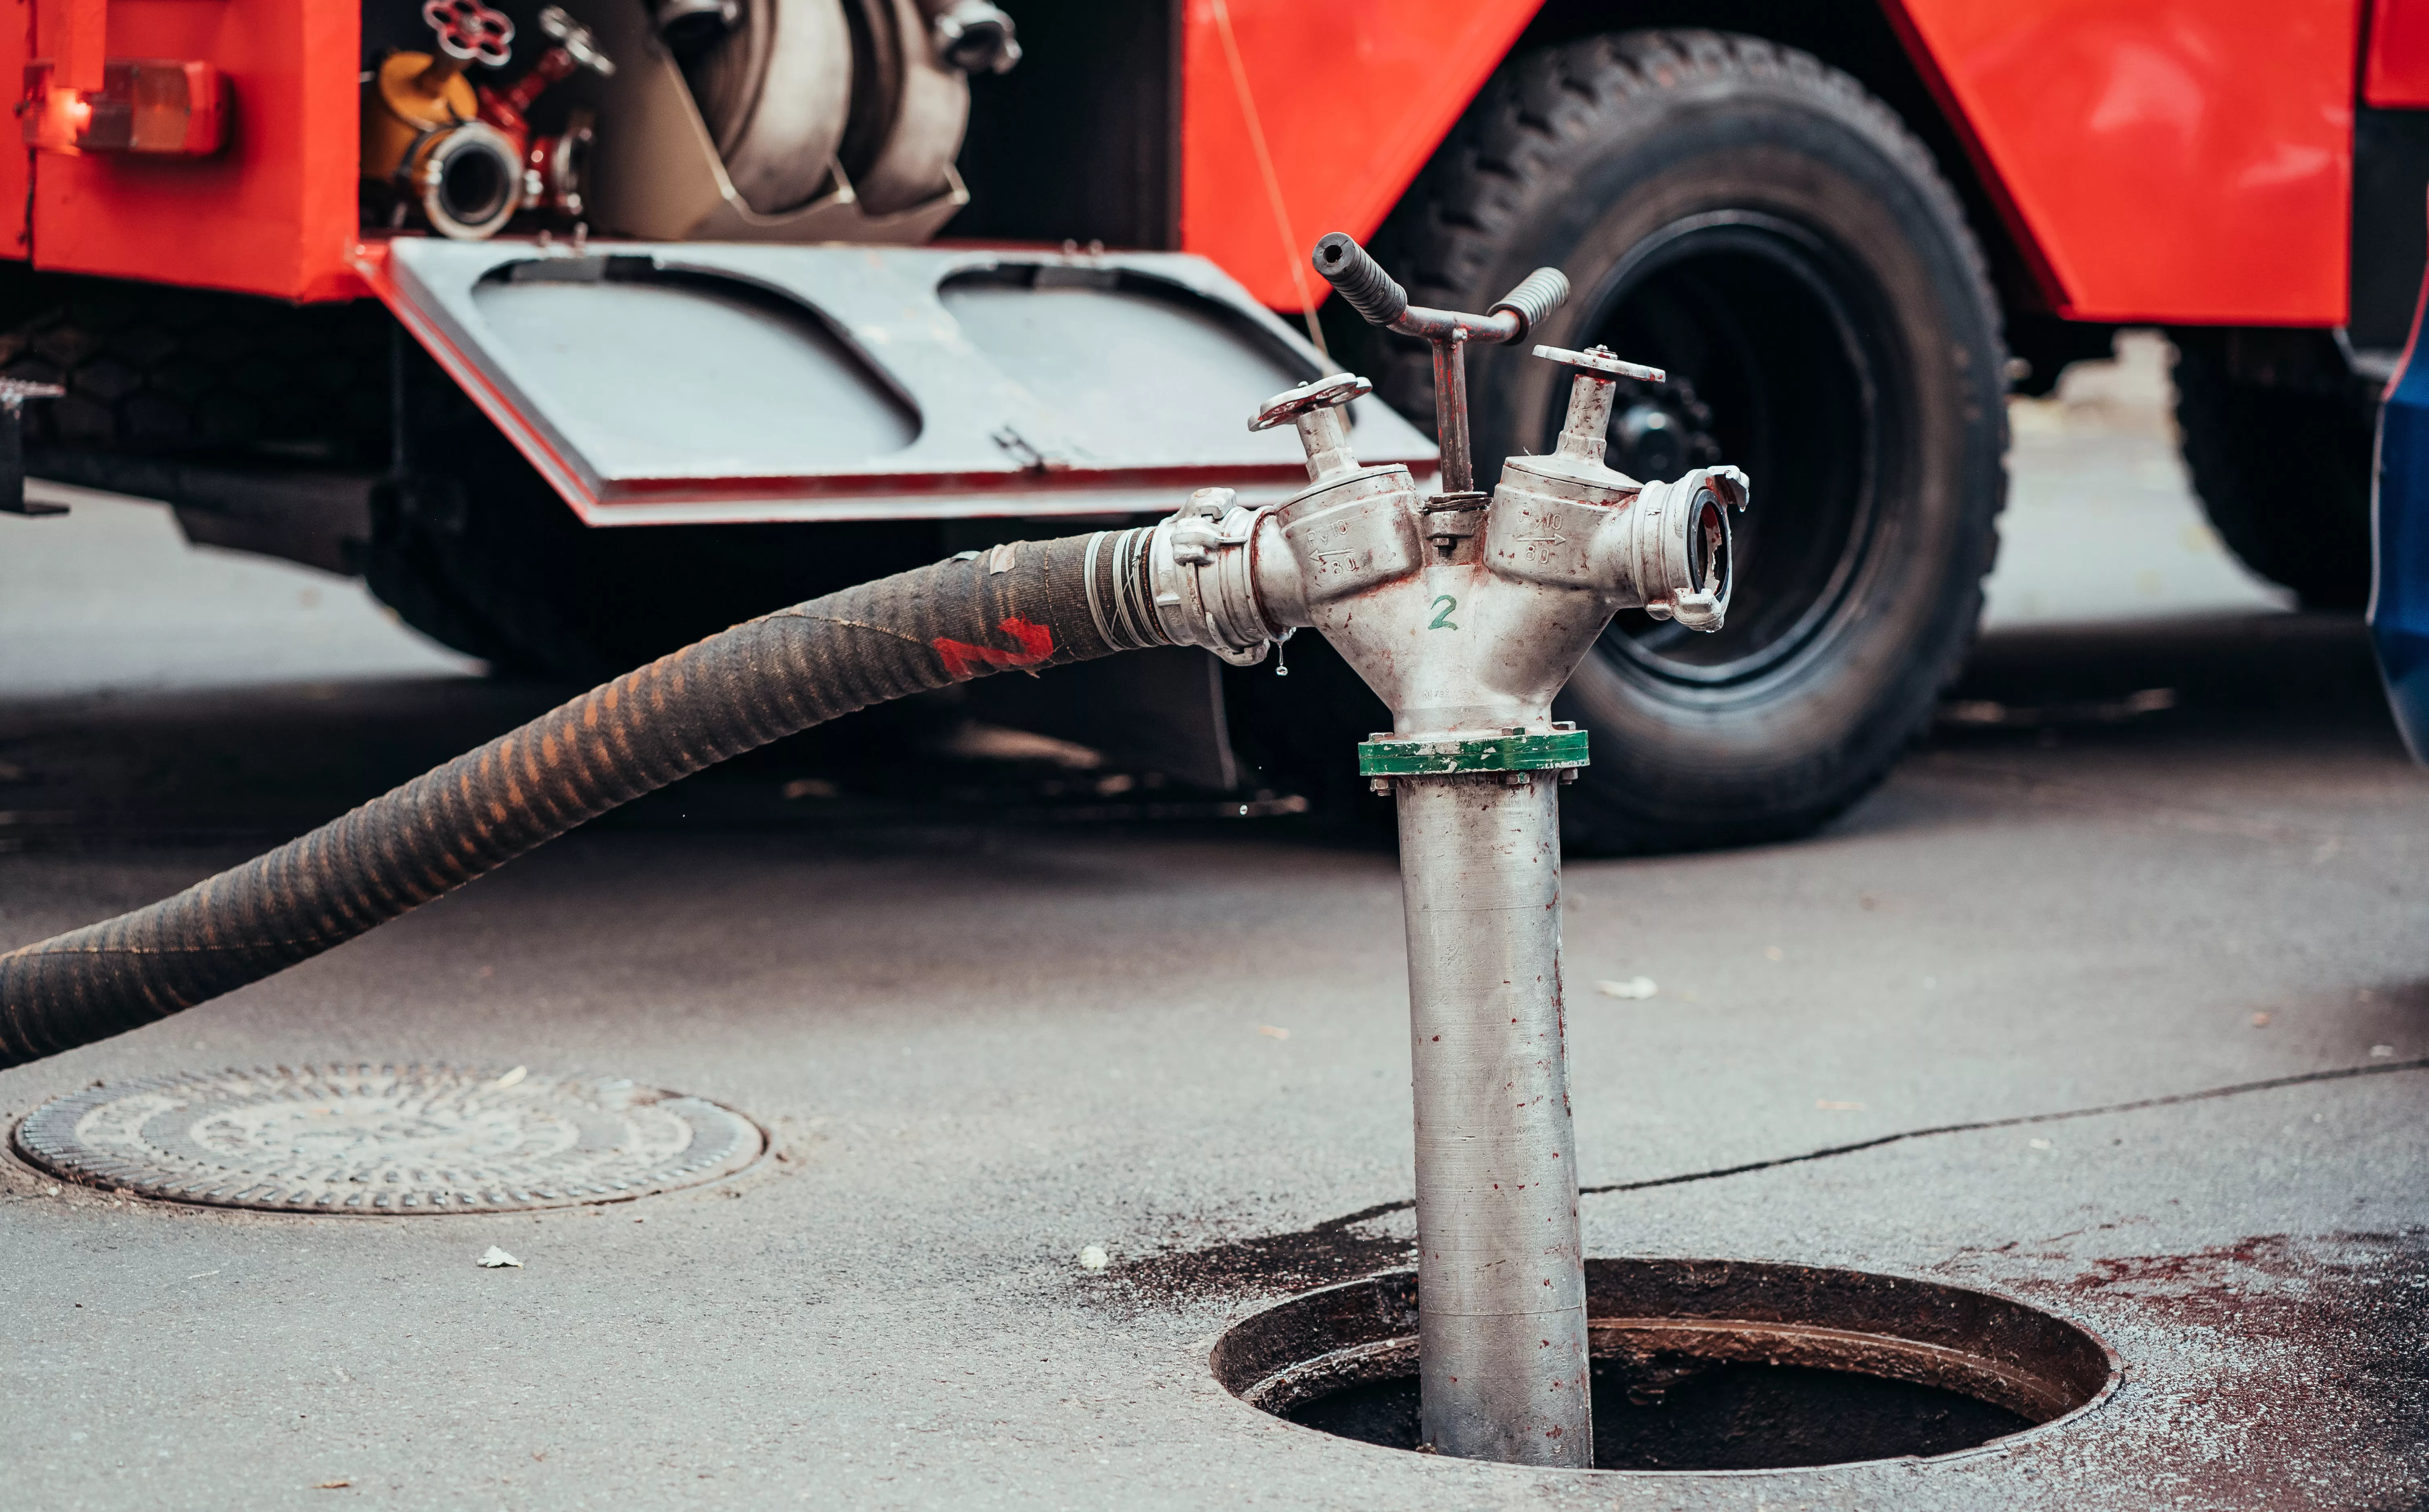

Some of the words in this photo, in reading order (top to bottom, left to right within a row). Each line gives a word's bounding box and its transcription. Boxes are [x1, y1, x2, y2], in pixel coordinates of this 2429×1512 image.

[1525, 545, 1550, 564] 80
[1331, 555, 1355, 576] 80
[1428, 595, 1458, 631] 2
